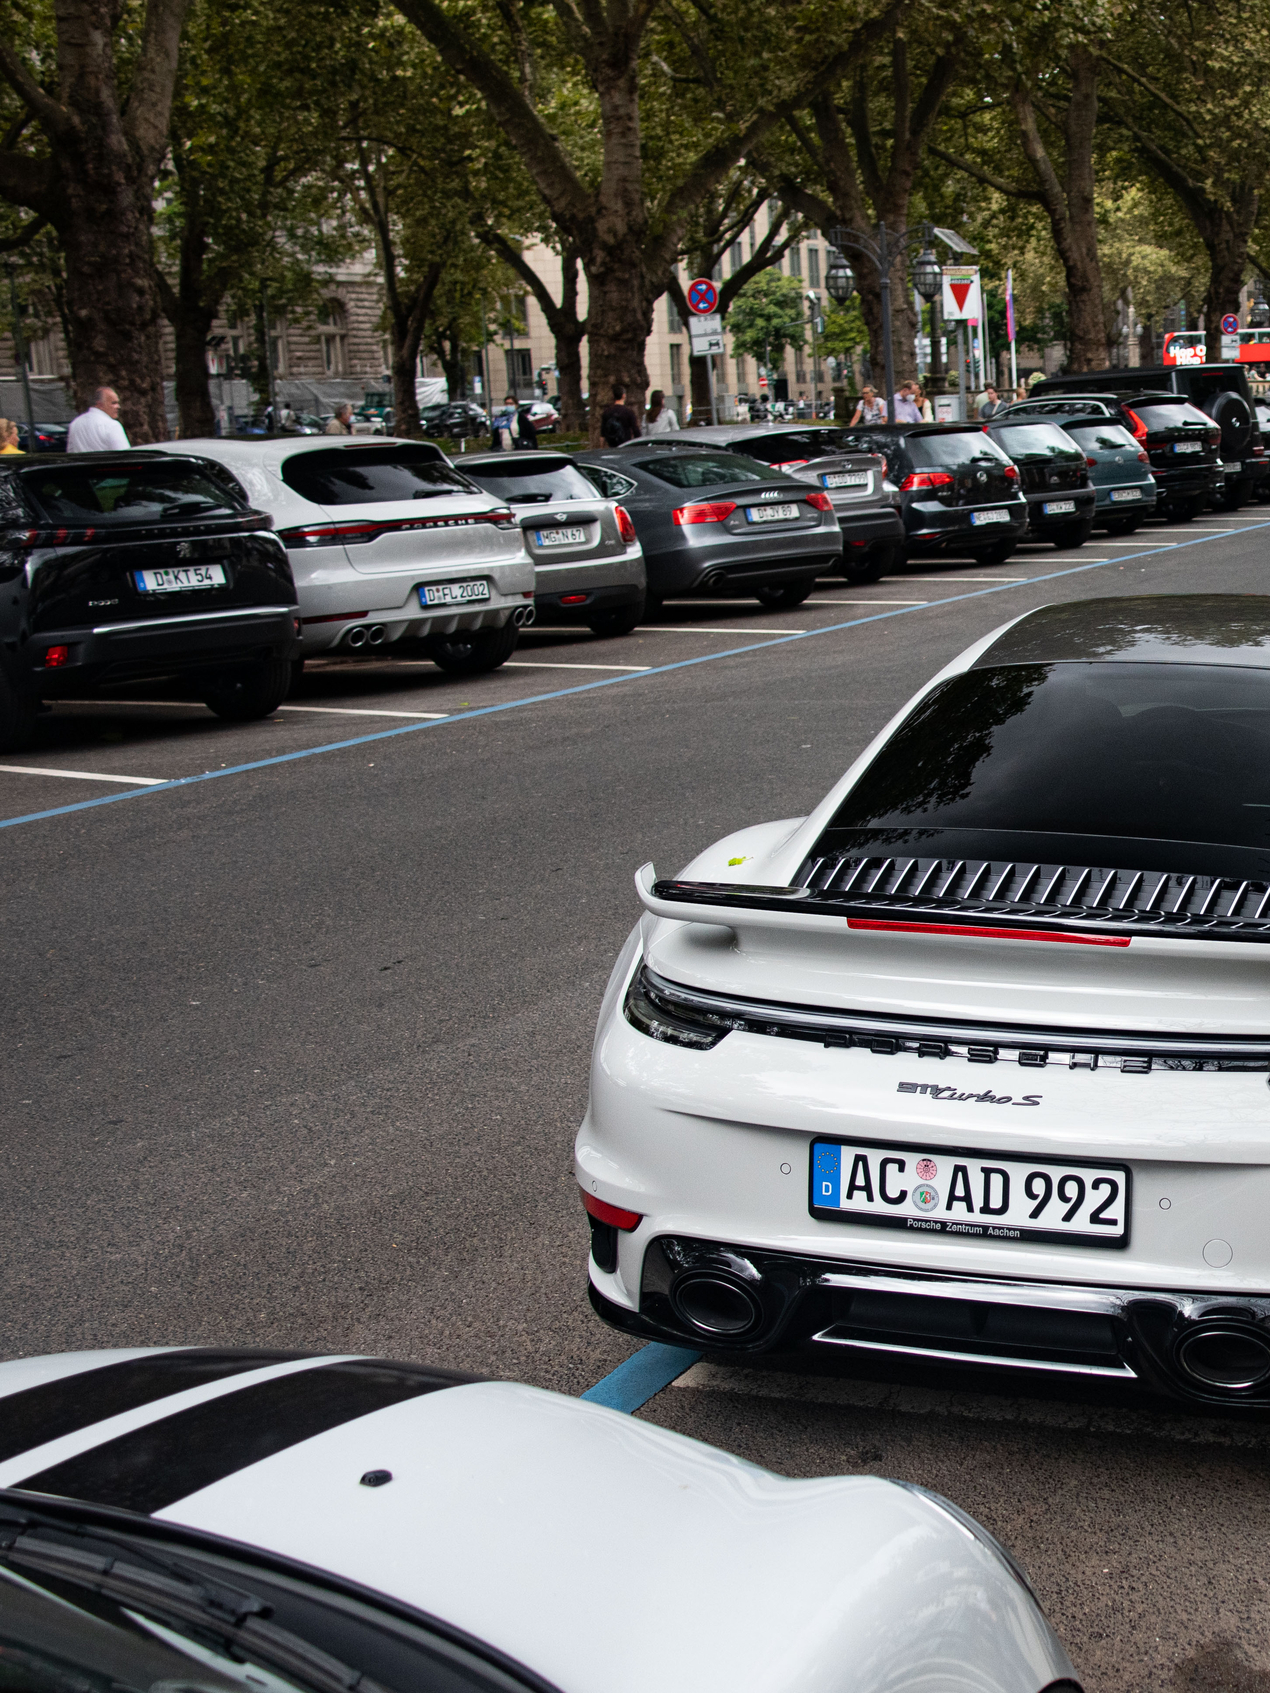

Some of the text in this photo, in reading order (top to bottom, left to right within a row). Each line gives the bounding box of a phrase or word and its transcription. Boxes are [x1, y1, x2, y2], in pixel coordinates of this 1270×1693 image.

[1170, 346, 1195, 358] Hop
[757, 508, 765, 519] D
[782, 505, 792, 516] 89
[402, 519, 475, 530] PORSCHE
[562, 530, 569, 541] N
[571, 529, 582, 540] 67
[154, 567, 213, 587] D KT 54
[427, 583, 487, 602] D FL 2002
[824, 1032, 1153, 1074] PORSCHE
[931, 1084, 1012, 1105] turbo
[1011, 1094, 1043, 1107] S
[821, 1181, 832, 1196] D
[846, 1153, 908, 1205] AC
[945, 1164, 1010, 1216] AD
[1024, 1171, 1120, 1226] 992
[907, 1218, 1020, 1238] Porsche Zentrum Aachen
